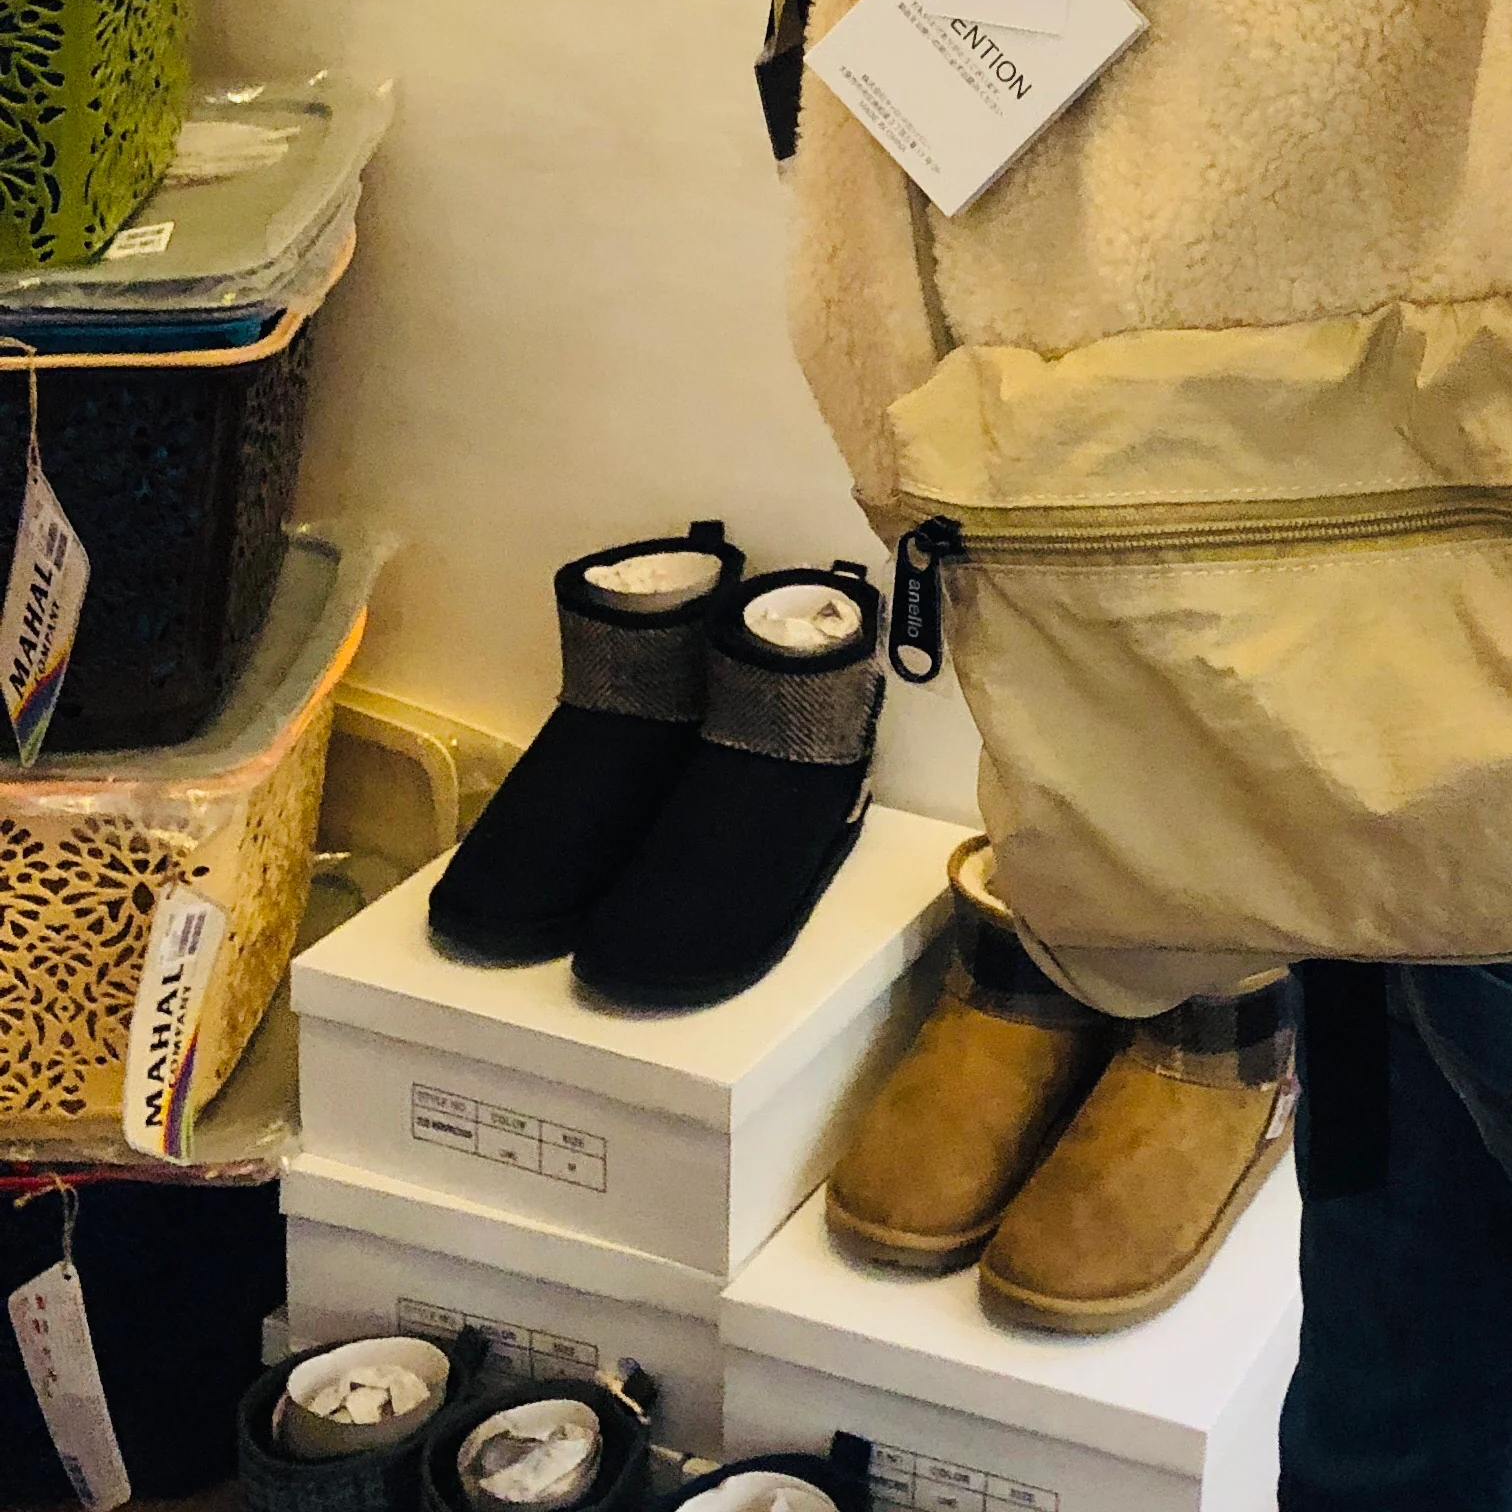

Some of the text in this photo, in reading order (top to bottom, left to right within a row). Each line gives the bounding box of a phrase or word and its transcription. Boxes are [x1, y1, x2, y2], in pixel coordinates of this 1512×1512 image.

[948, 14, 1033, 100] ENTION
[8, 561, 57, 697] MAHAL
[907, 578, 922, 639] anello
[145, 963, 185, 1129] MAHAL
[168, 985, 192, 1089] COMPANY
